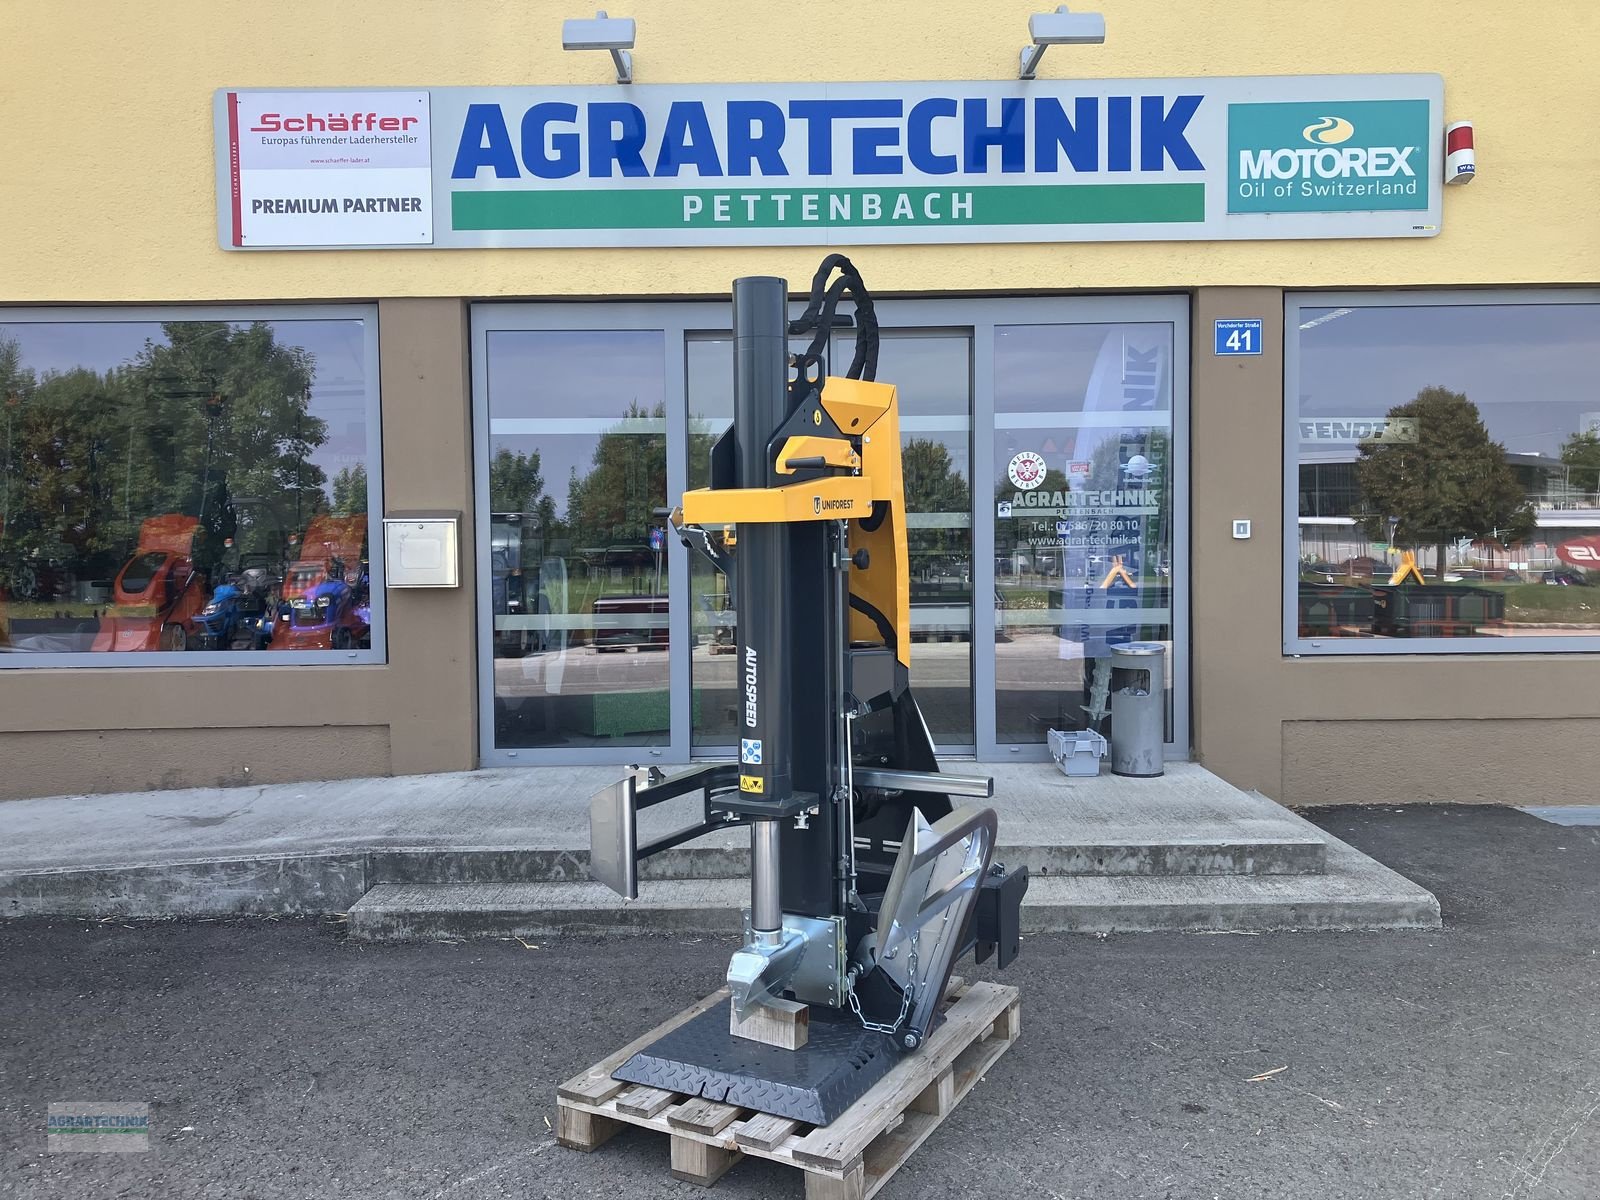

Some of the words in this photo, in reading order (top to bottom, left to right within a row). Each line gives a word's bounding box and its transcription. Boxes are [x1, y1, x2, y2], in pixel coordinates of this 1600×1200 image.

[250, 113, 418, 132] Schäffer
[261, 136, 299, 147] Europas
[301, 135, 347, 145] führender
[349, 134, 418, 145] Laderhersteller
[450, 95, 1206, 180] AGRARTECHNIK
[1239, 146, 1415, 180] MOTOREX
[1239, 181, 1265, 198] Oil
[1274, 181, 1293, 198] of
[1301, 179, 1417, 197] Switzerland
[252, 198, 339, 214] PREMIUM
[343, 197, 422, 213] PARTNER
[682, 192, 973, 222] PETTENBACH
[1225, 329, 1251, 351] 41
[1299, 421, 1391, 439] FENDT
[1011, 452, 1044, 466] MEISTER
[1010, 474, 1044, 488] BETRIEB
[821, 499, 854, 510] UNIFOREST
[1012, 490, 1159, 507] AGRARTECHNIK
[1031, 521, 1054, 531] Tel.:
[1110, 520, 1123, 530] 80
[1125, 520, 1138, 530] 10
[1028, 534, 1143, 547] www.agrar-technik.at
[745, 645, 757, 728] AUTOSPEED
